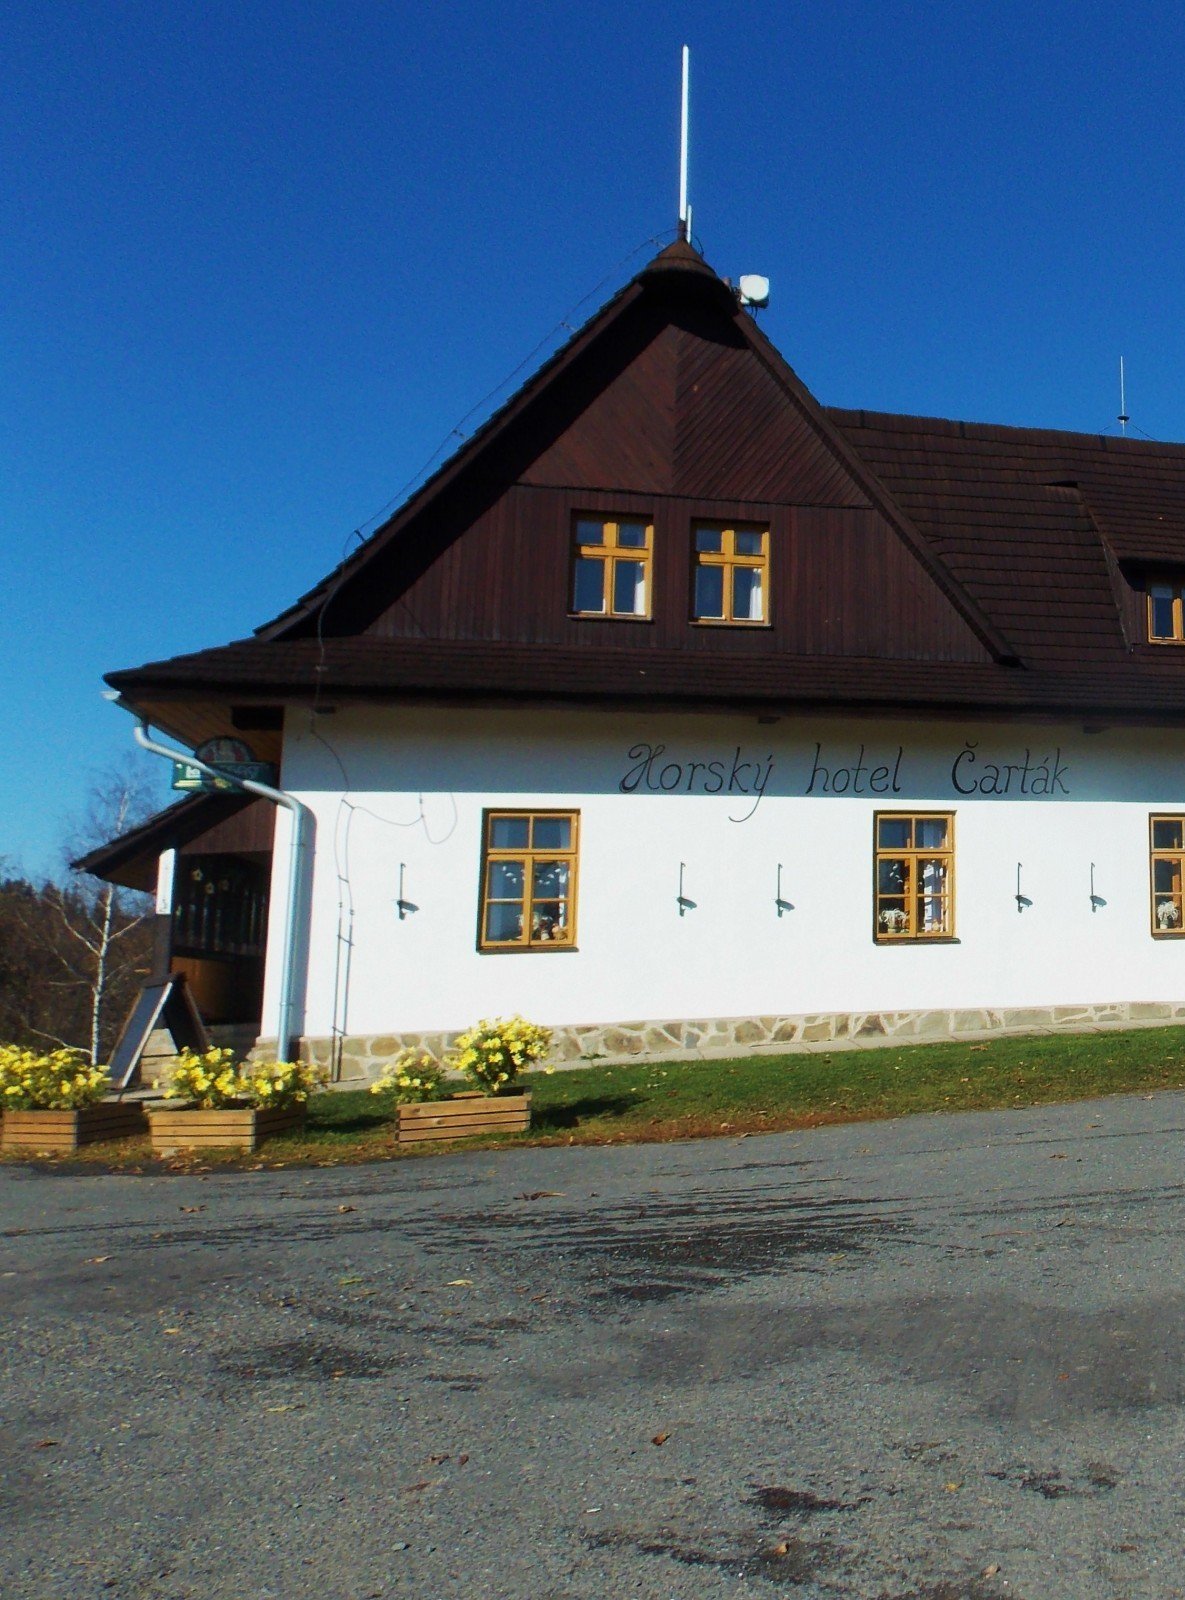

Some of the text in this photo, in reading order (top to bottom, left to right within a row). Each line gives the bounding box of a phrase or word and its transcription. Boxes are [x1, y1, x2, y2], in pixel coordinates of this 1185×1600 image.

[618, 740, 1070, 823] Horský hotel Čarták
